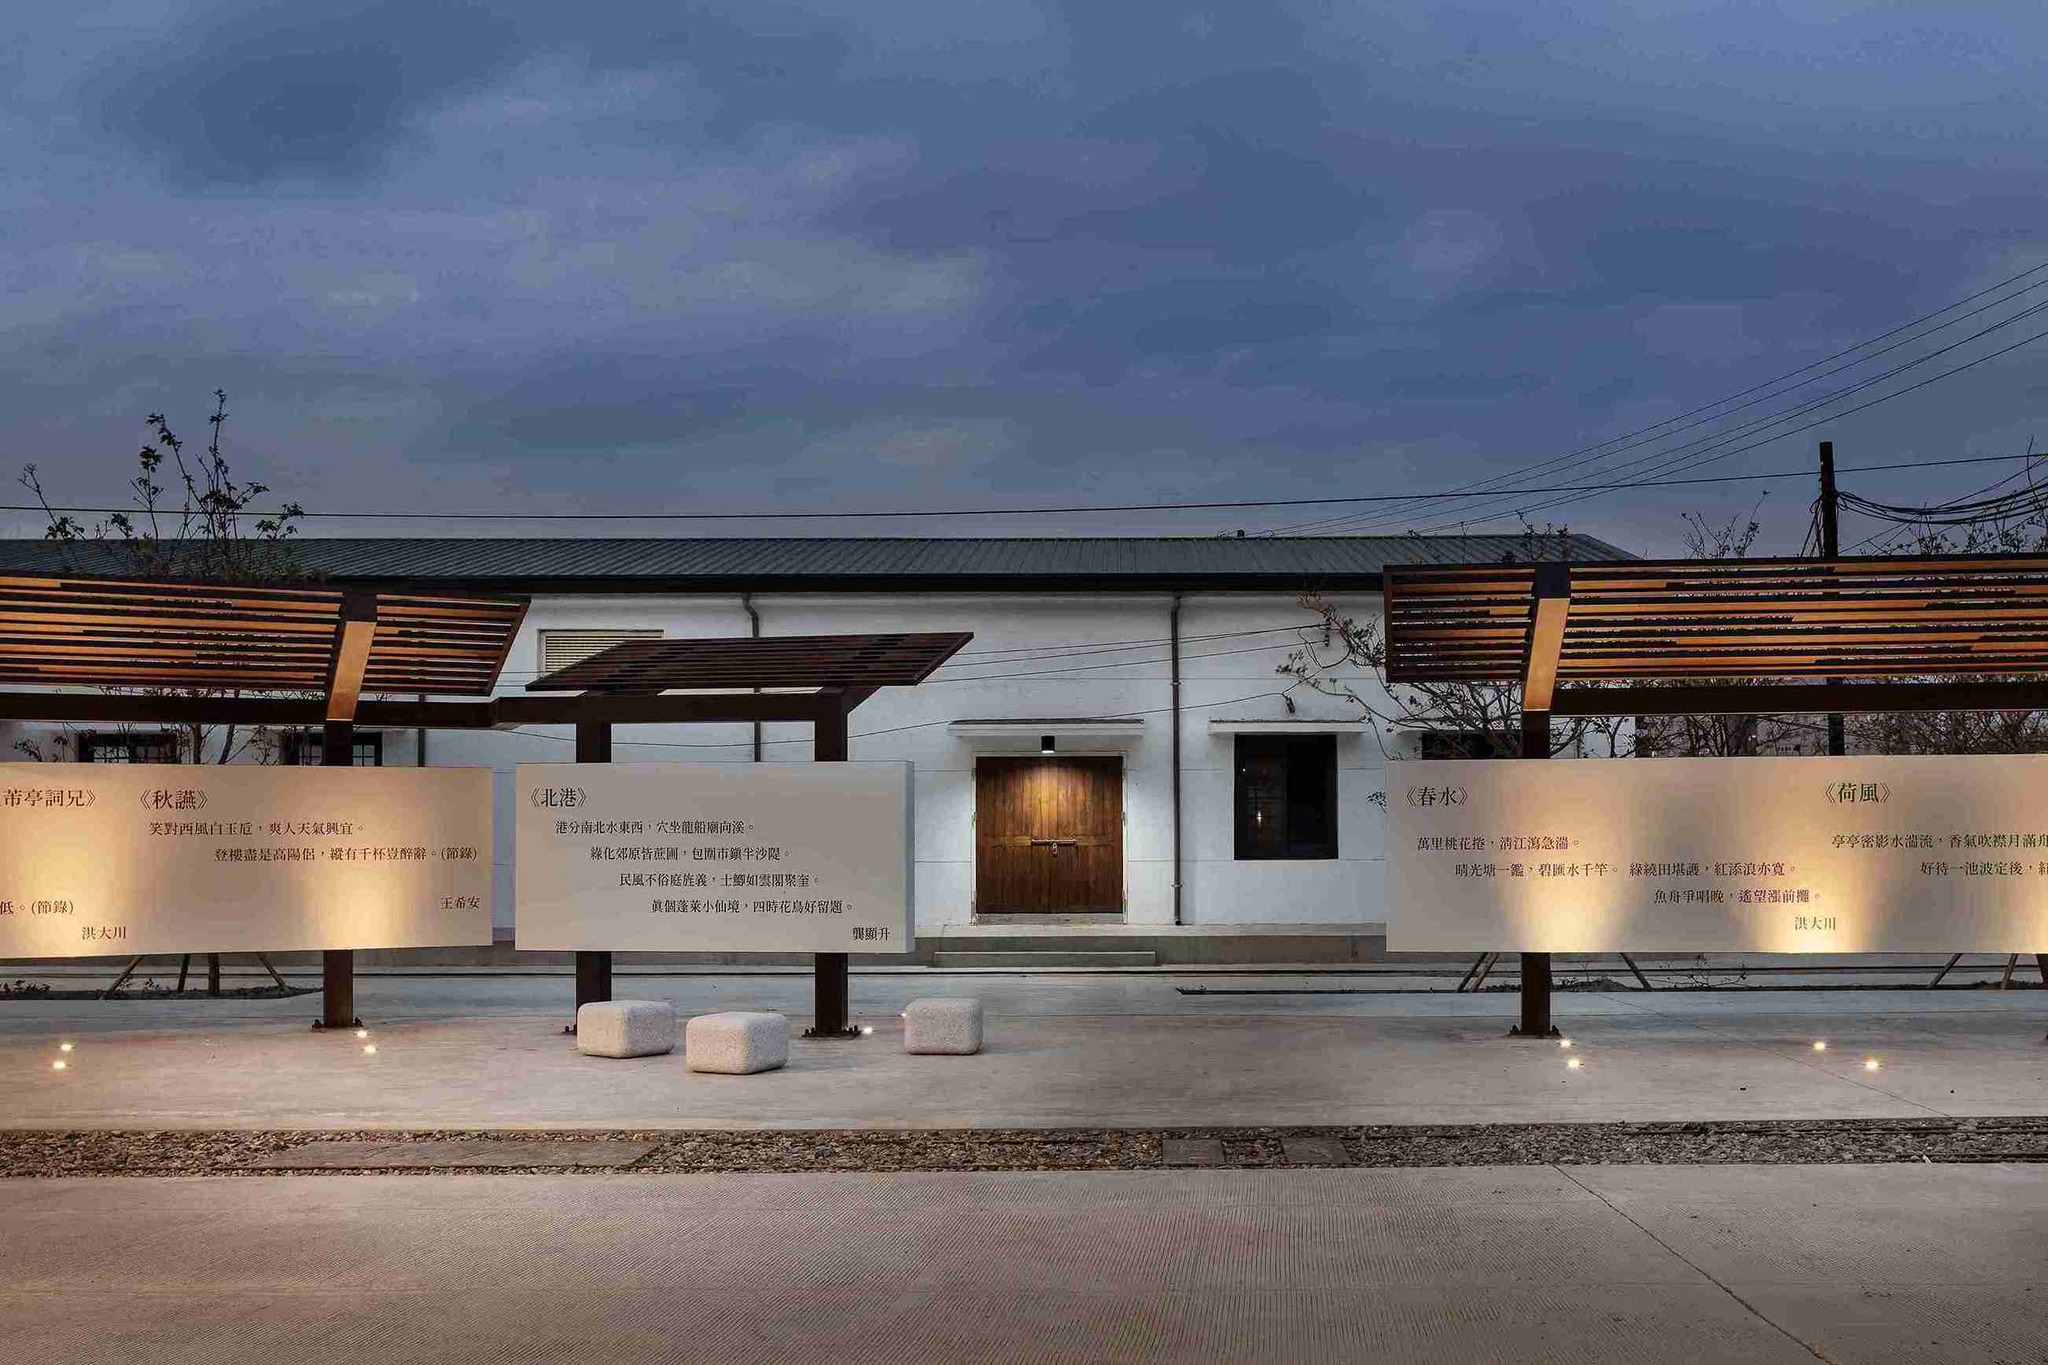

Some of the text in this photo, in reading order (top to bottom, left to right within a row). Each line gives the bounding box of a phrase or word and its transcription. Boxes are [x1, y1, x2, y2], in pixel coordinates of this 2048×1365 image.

[529, 786, 588, 809] 《北港》
[1406, 786, 1470, 808] 《春水》
[1824, 780, 1890, 805] 《荷風》
[441, 896, 480, 912] 王希安
[1795, 915, 1835, 931] 洪大川
[82, 926, 126, 942] 洪大川
[853, 925, 890, 941] 龔顯升
